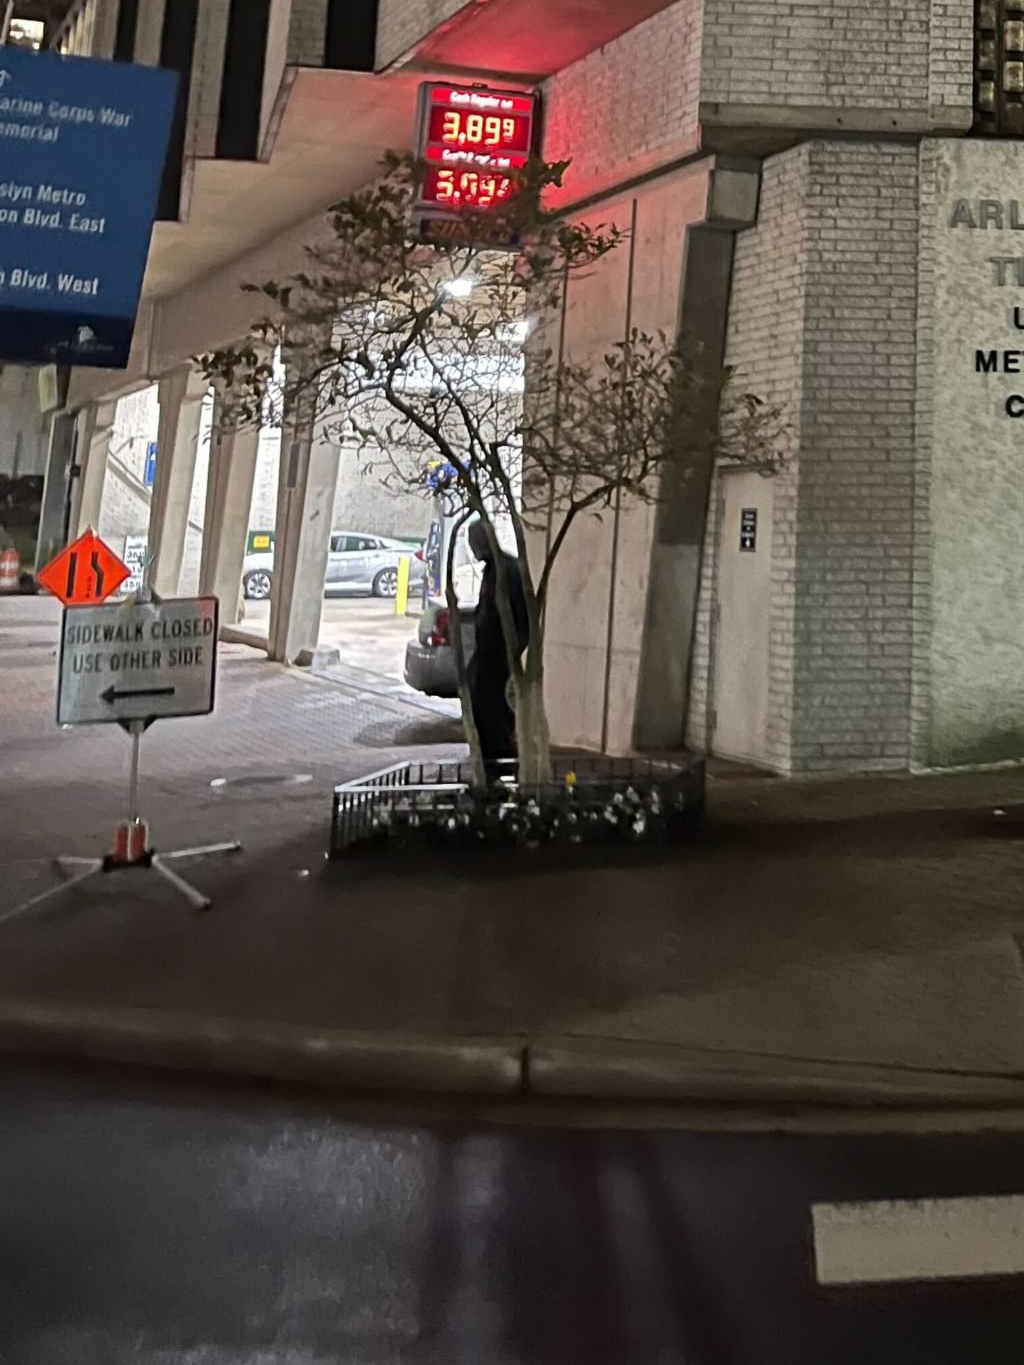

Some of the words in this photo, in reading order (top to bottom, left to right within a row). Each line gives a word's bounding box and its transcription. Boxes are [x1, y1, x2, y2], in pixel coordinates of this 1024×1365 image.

[48, 101, 95, 123] Corps
[101, 107, 132, 127] War
[37, 184, 87, 206] Metro
[23, 208, 63, 229] Blvd.
[69, 213, 105, 233] East
[10, 268, 50, 289] Blvd.
[57, 273, 98, 294] West
[66, 620, 145, 645] SIDEWALK
[151, 617, 213, 638] CLOSED
[72, 652, 102, 675] USE
[109, 650, 162, 672] OTHER
[168, 645, 204, 667] SIDE
